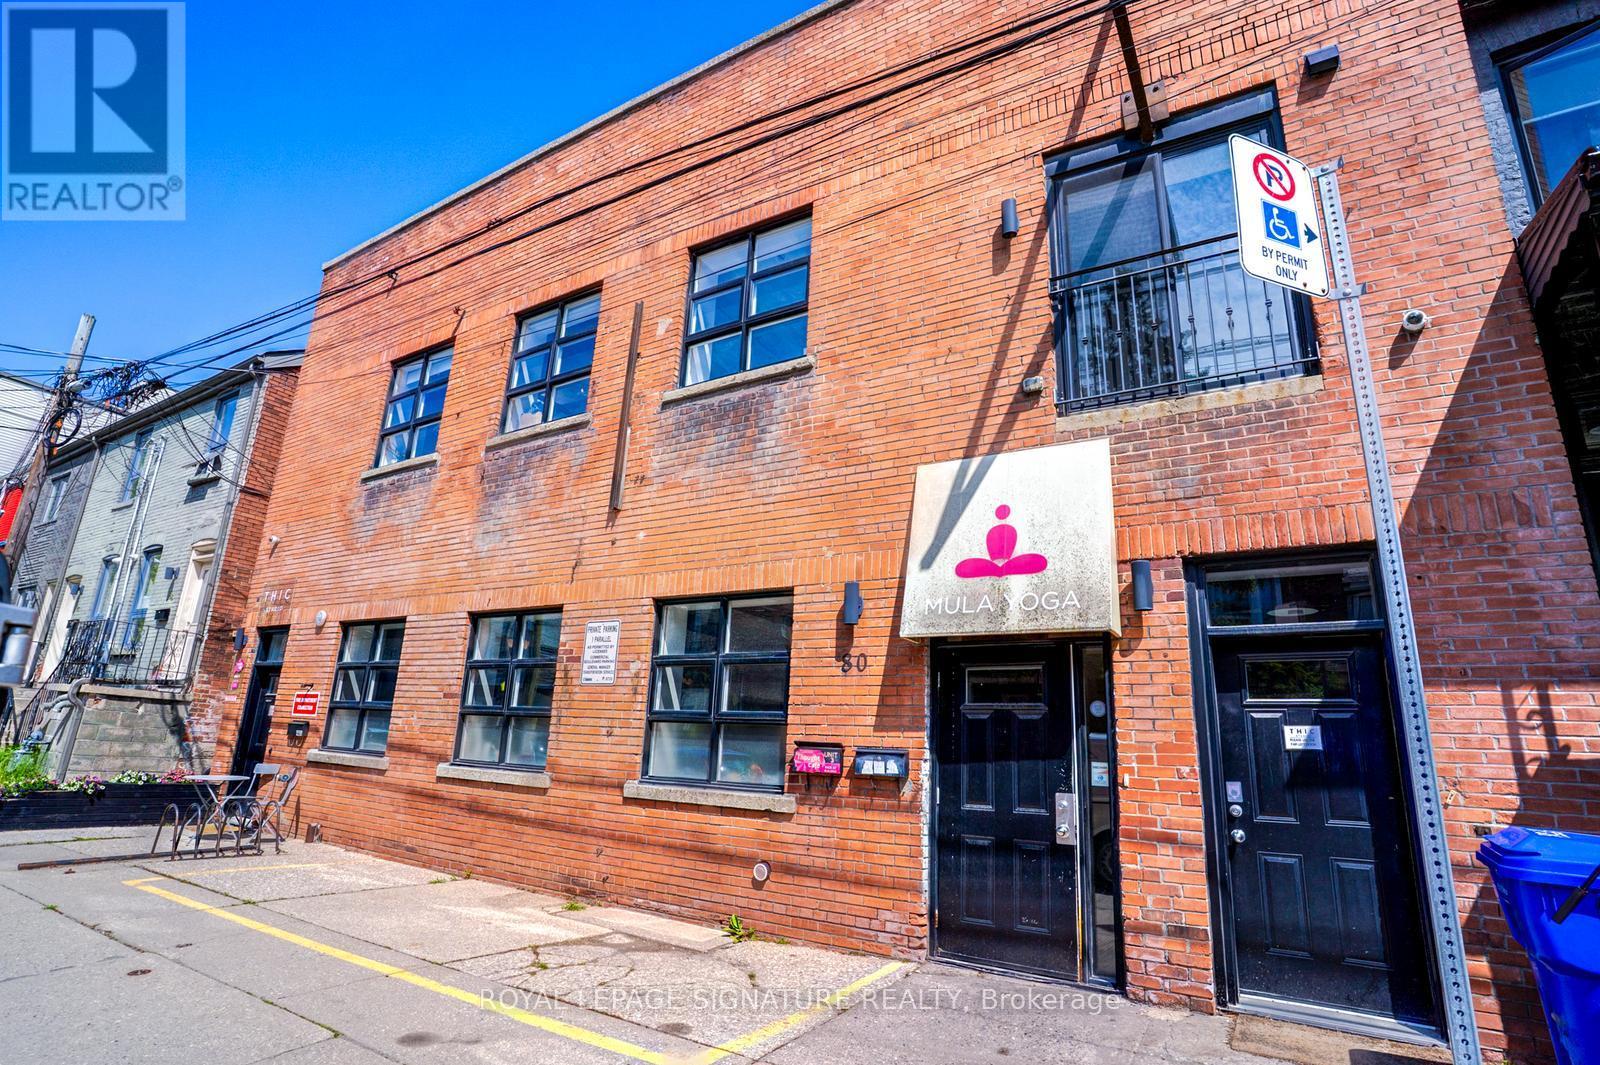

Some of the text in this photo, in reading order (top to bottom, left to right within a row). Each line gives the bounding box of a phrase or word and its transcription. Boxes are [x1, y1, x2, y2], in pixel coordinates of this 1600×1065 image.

[1261, 246, 1308, 270] BY PERMIT
[1276, 265, 1298, 281] ONLY
[264, 589, 291, 602] THIC
[925, 590, 1081, 615] MULA YOGA
[841, 653, 867, 673] 80
